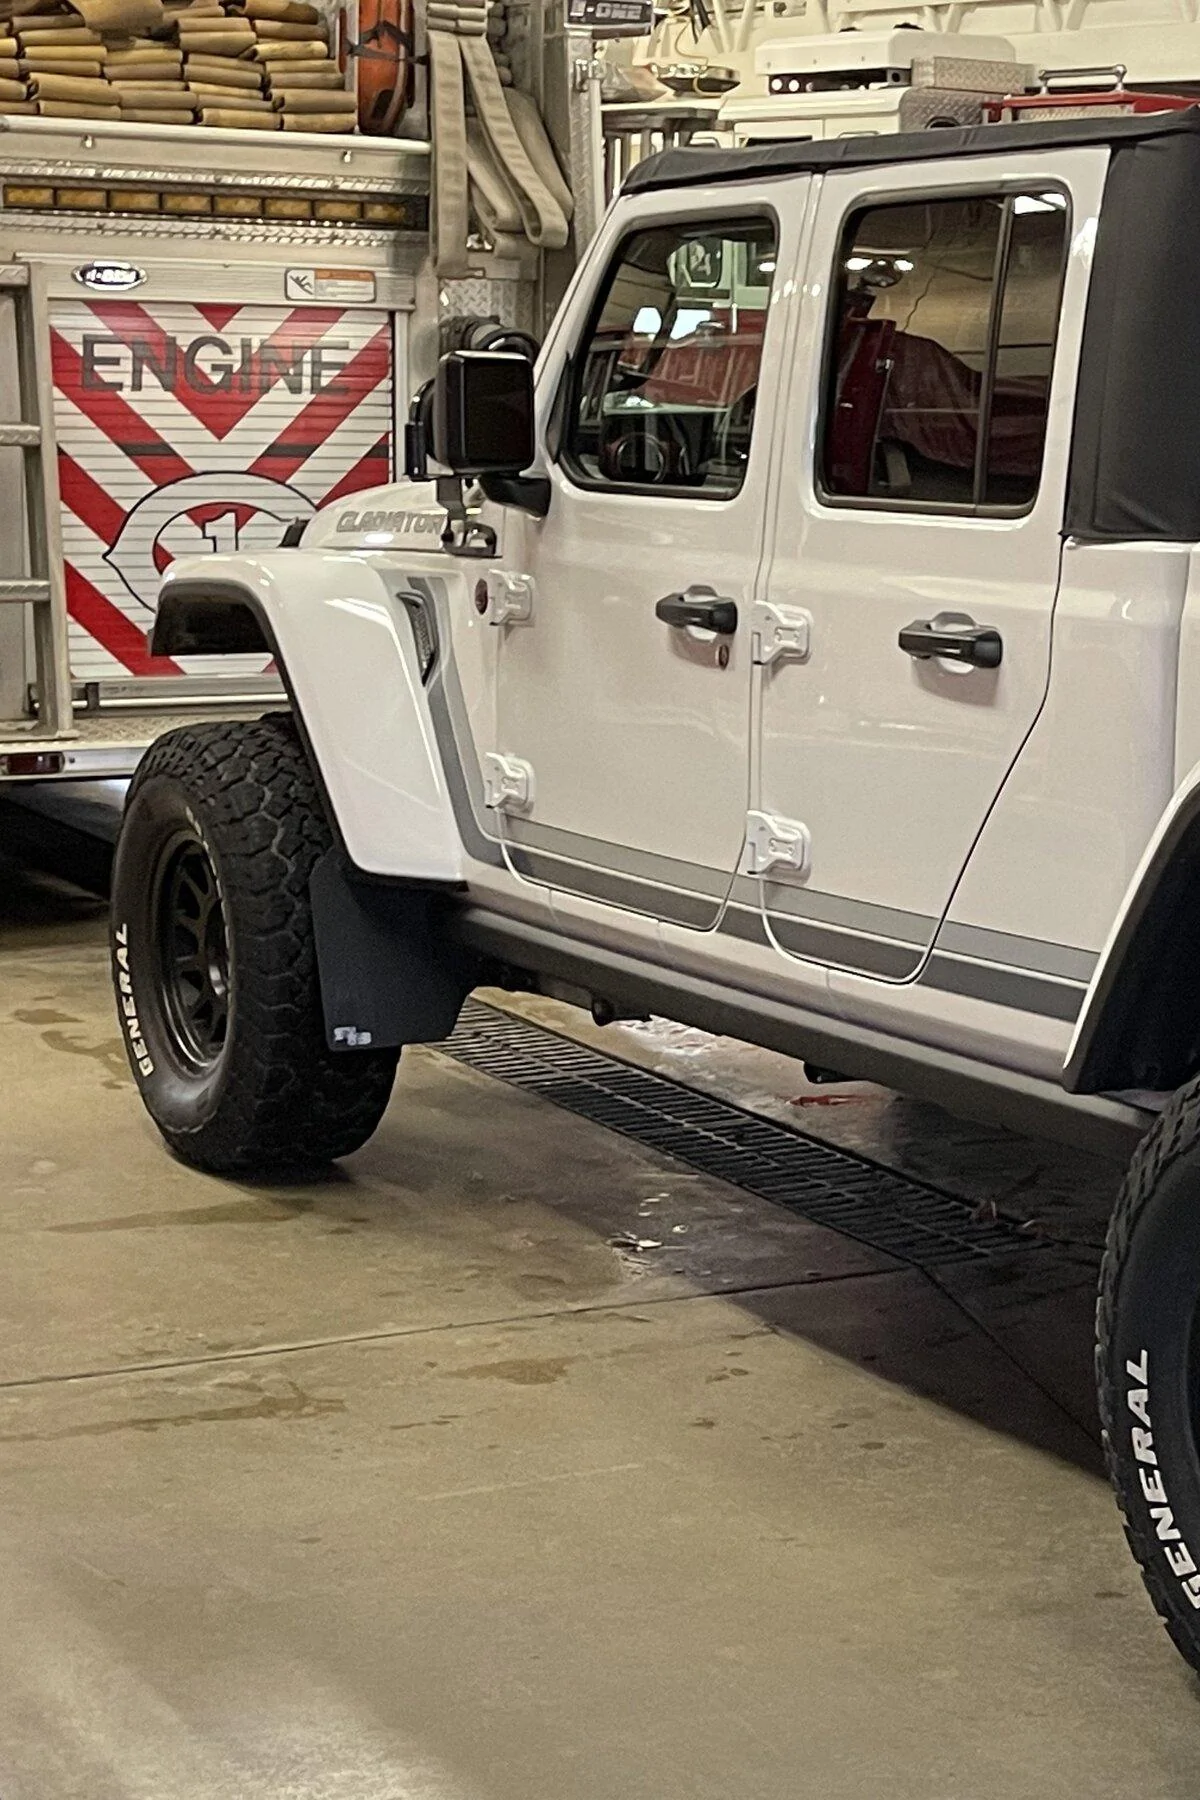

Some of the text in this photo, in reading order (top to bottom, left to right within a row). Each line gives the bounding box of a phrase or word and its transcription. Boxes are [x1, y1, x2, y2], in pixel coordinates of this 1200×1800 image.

[82, 333, 350, 395] ENGINE
[336, 510, 447, 534] GLADIATOR
[115, 923, 154, 1077] GENERAL
